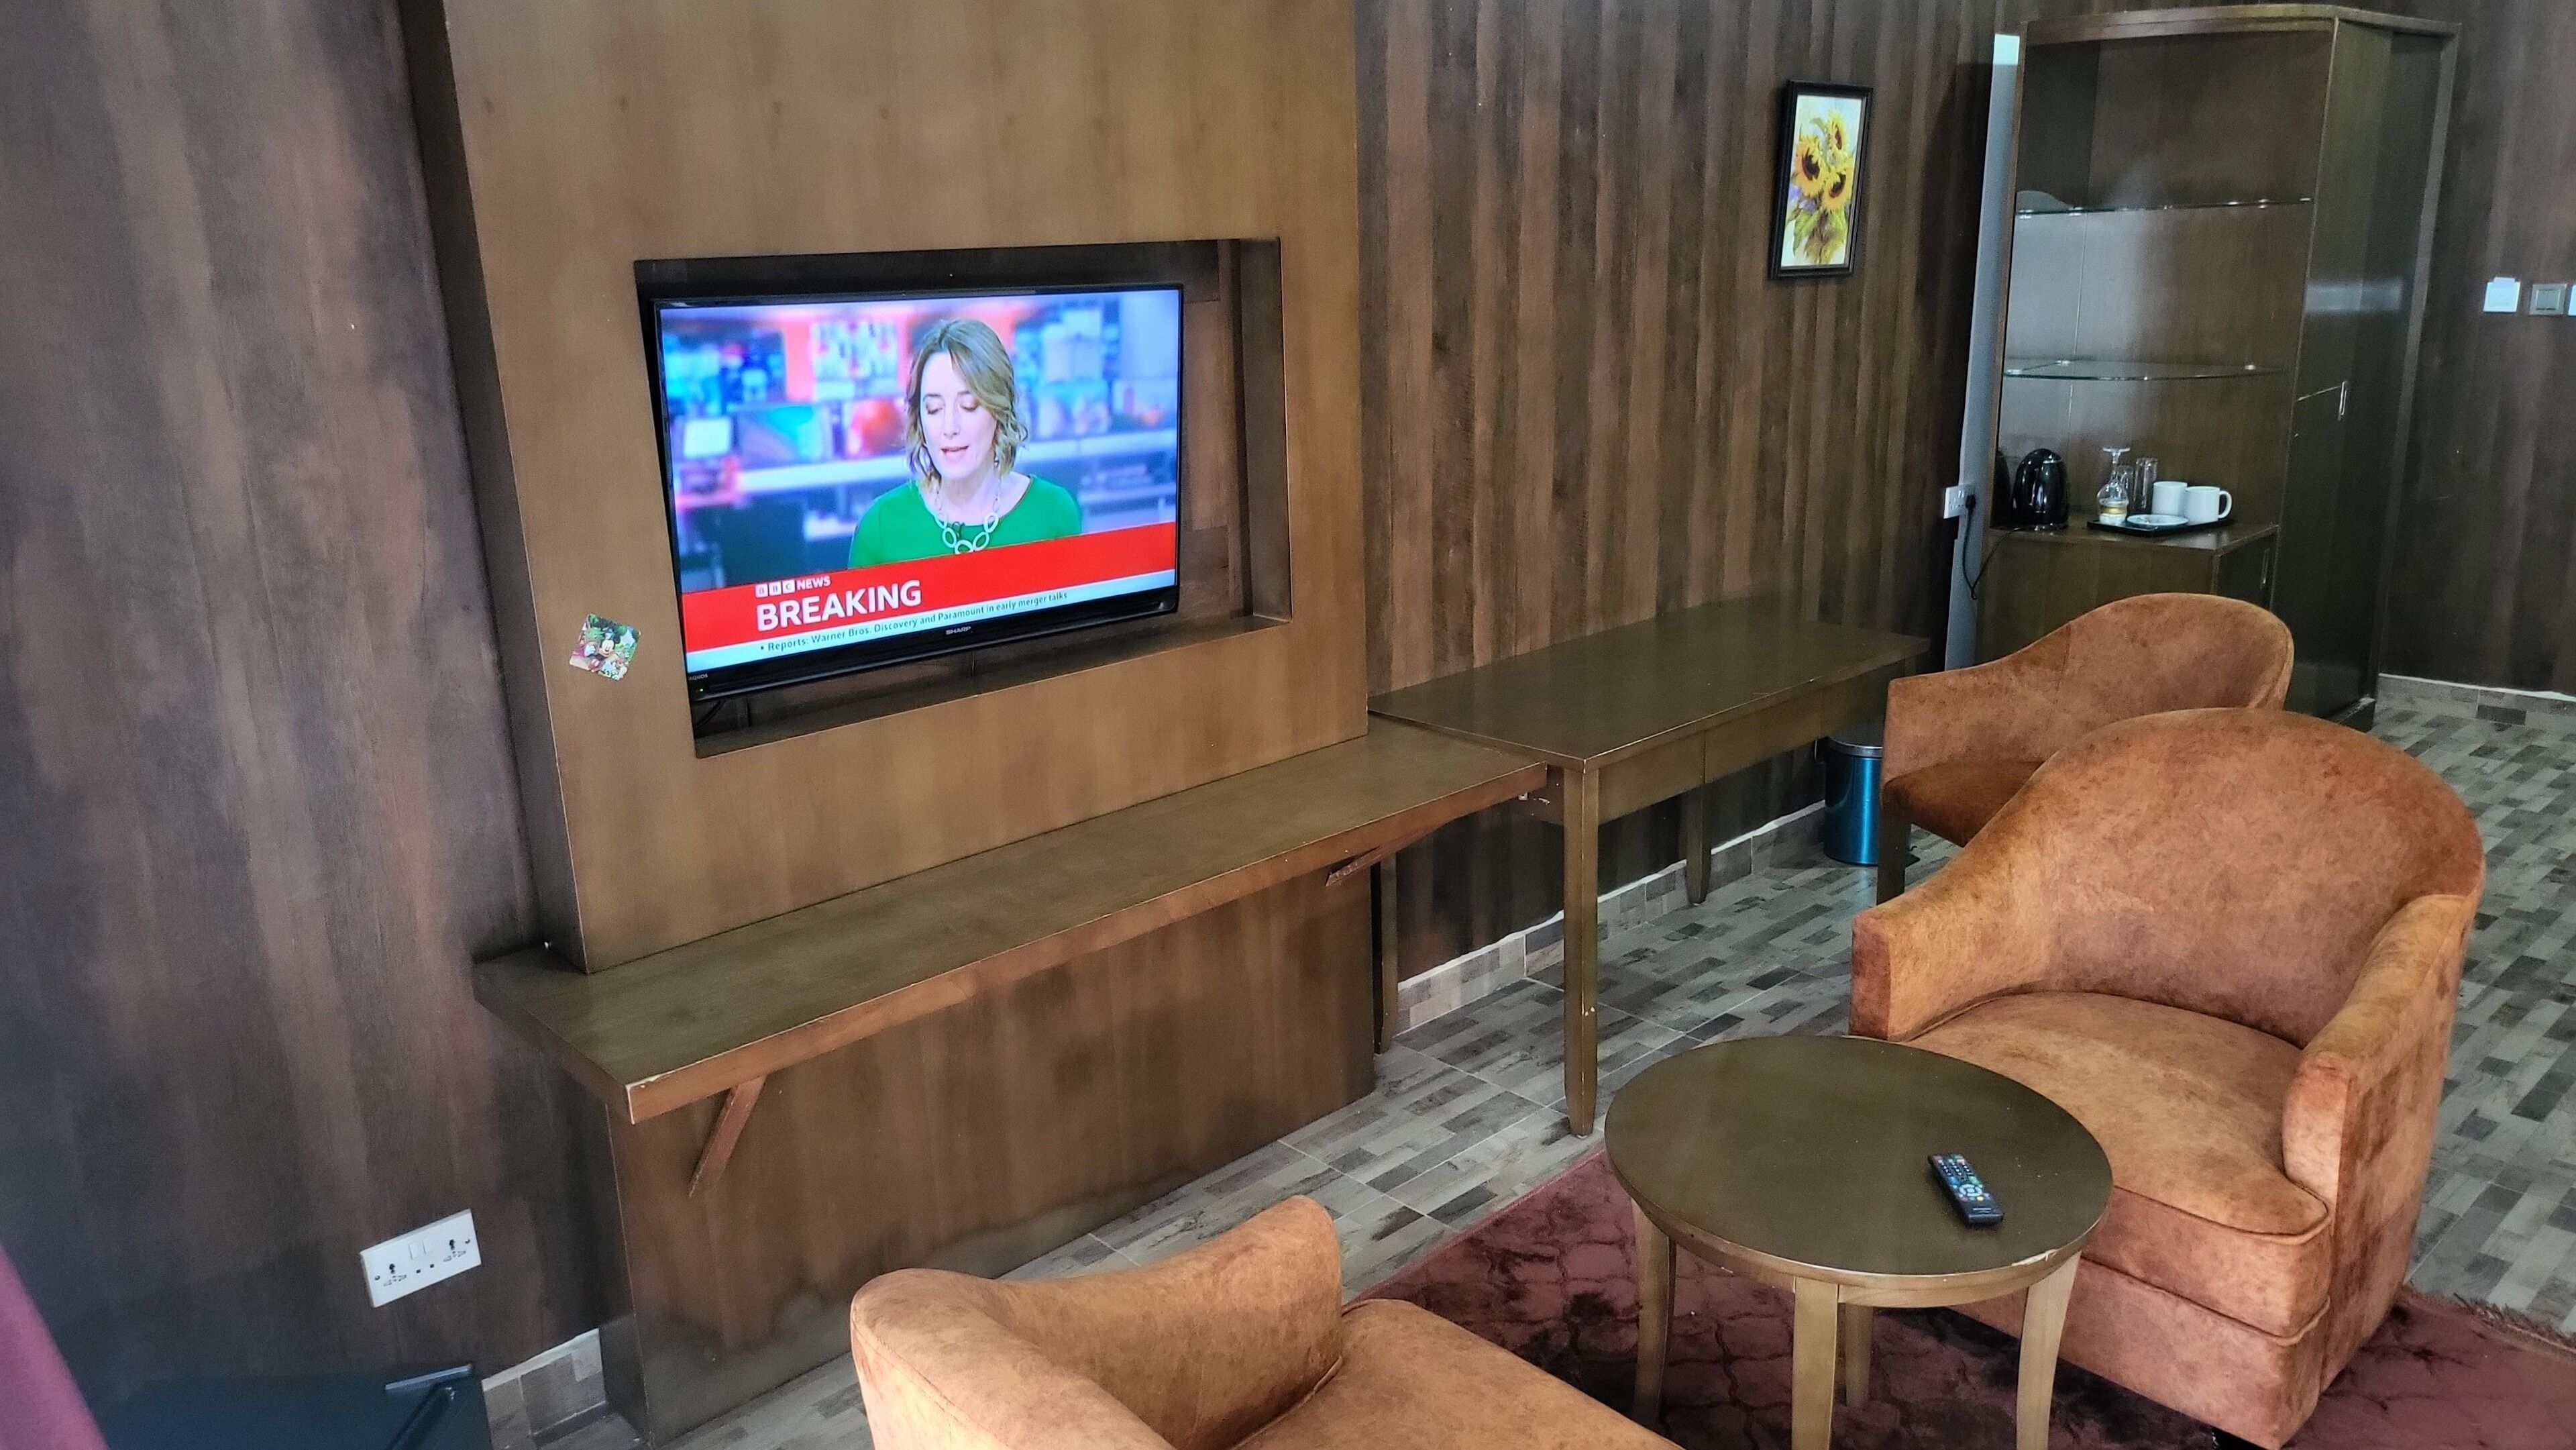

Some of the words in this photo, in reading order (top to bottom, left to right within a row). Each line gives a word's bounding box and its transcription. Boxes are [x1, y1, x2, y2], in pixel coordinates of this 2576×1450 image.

[755, 580, 795, 598] BBC
[797, 576, 831, 590] NEWS
[756, 580, 922, 632] BREAKING
[767, 637, 809, 653] Reports:
[811, 631, 845, 644] Warner
[849, 627, 871, 637] Bros.
[874, 617, 917, 633] Discovery
[920, 614, 936, 625] and
[938, 607, 985, 622] Paramount
[986, 605, 995, 613] in
[996, 601, 1016, 612] early
[1018, 595, 1047, 607] merger
[1049, 591, 1068, 602] talks
[945, 626, 971, 635] SHARP
[688, 673, 708, 681] AQUOS
